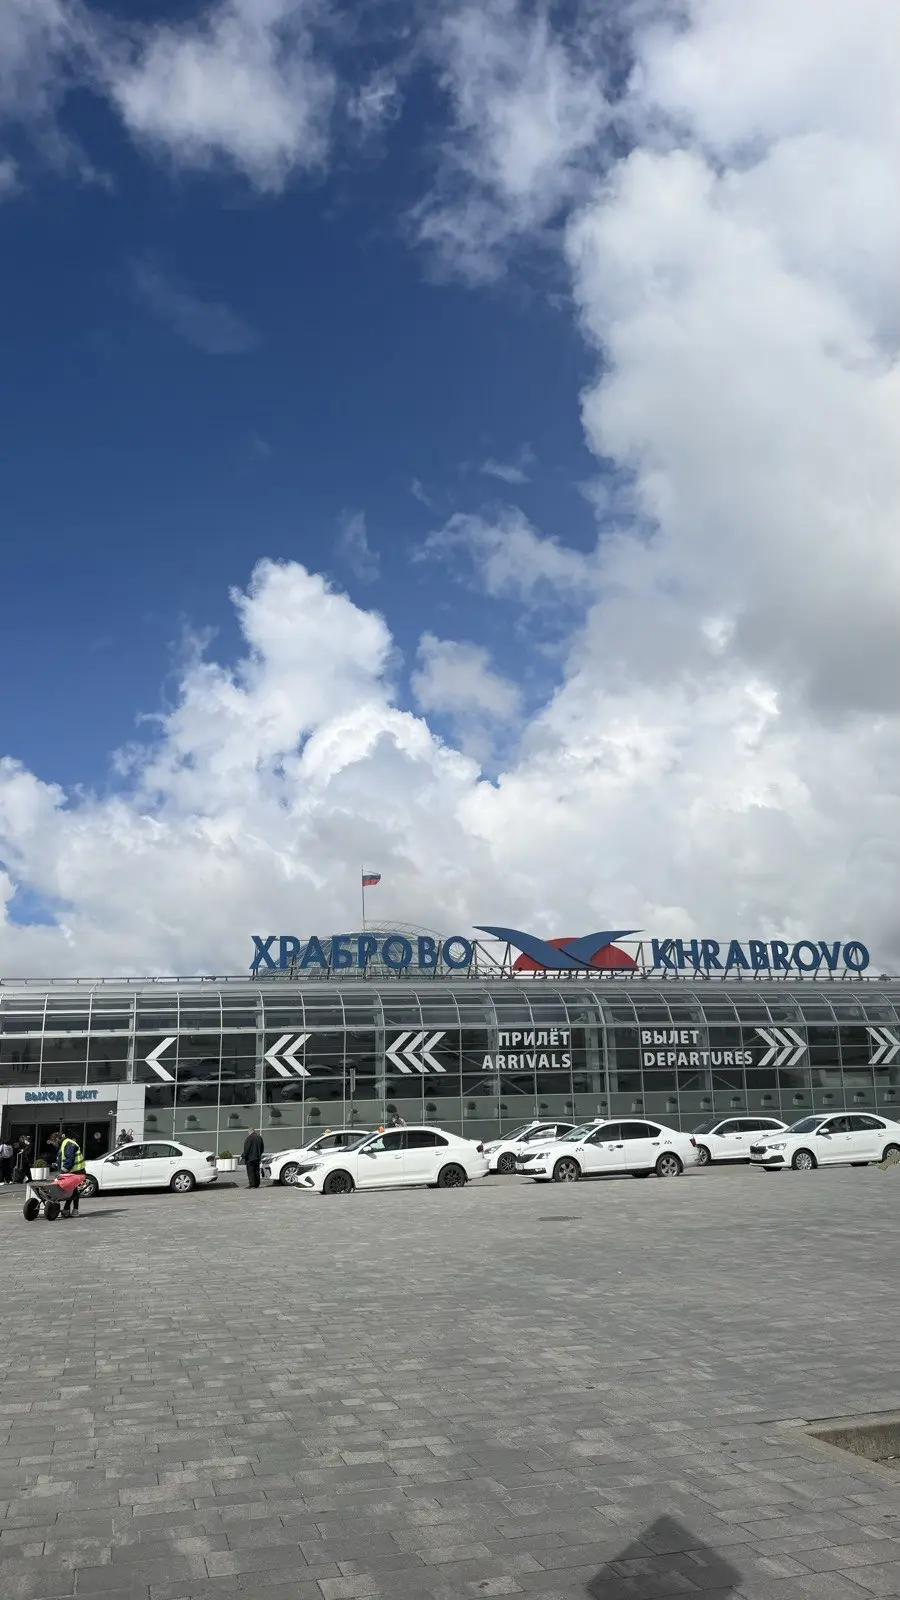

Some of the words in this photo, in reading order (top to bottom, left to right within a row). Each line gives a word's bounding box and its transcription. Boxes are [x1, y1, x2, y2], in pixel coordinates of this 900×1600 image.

[250, 935, 473, 969] ХРАБРОВО
[651, 938, 870, 972] KHRABROVO
[498, 1029, 570, 1046] ПРИЛЁТ
[641, 1030, 700, 1045] ВЫЛЕТ
[482, 1053, 571, 1069] ARRIVALS
[644, 1051, 753, 1067] DEPARTURES
[24, 1091, 64, 1102] ВЫХОД
[75, 1089, 98, 1100] EXIT
